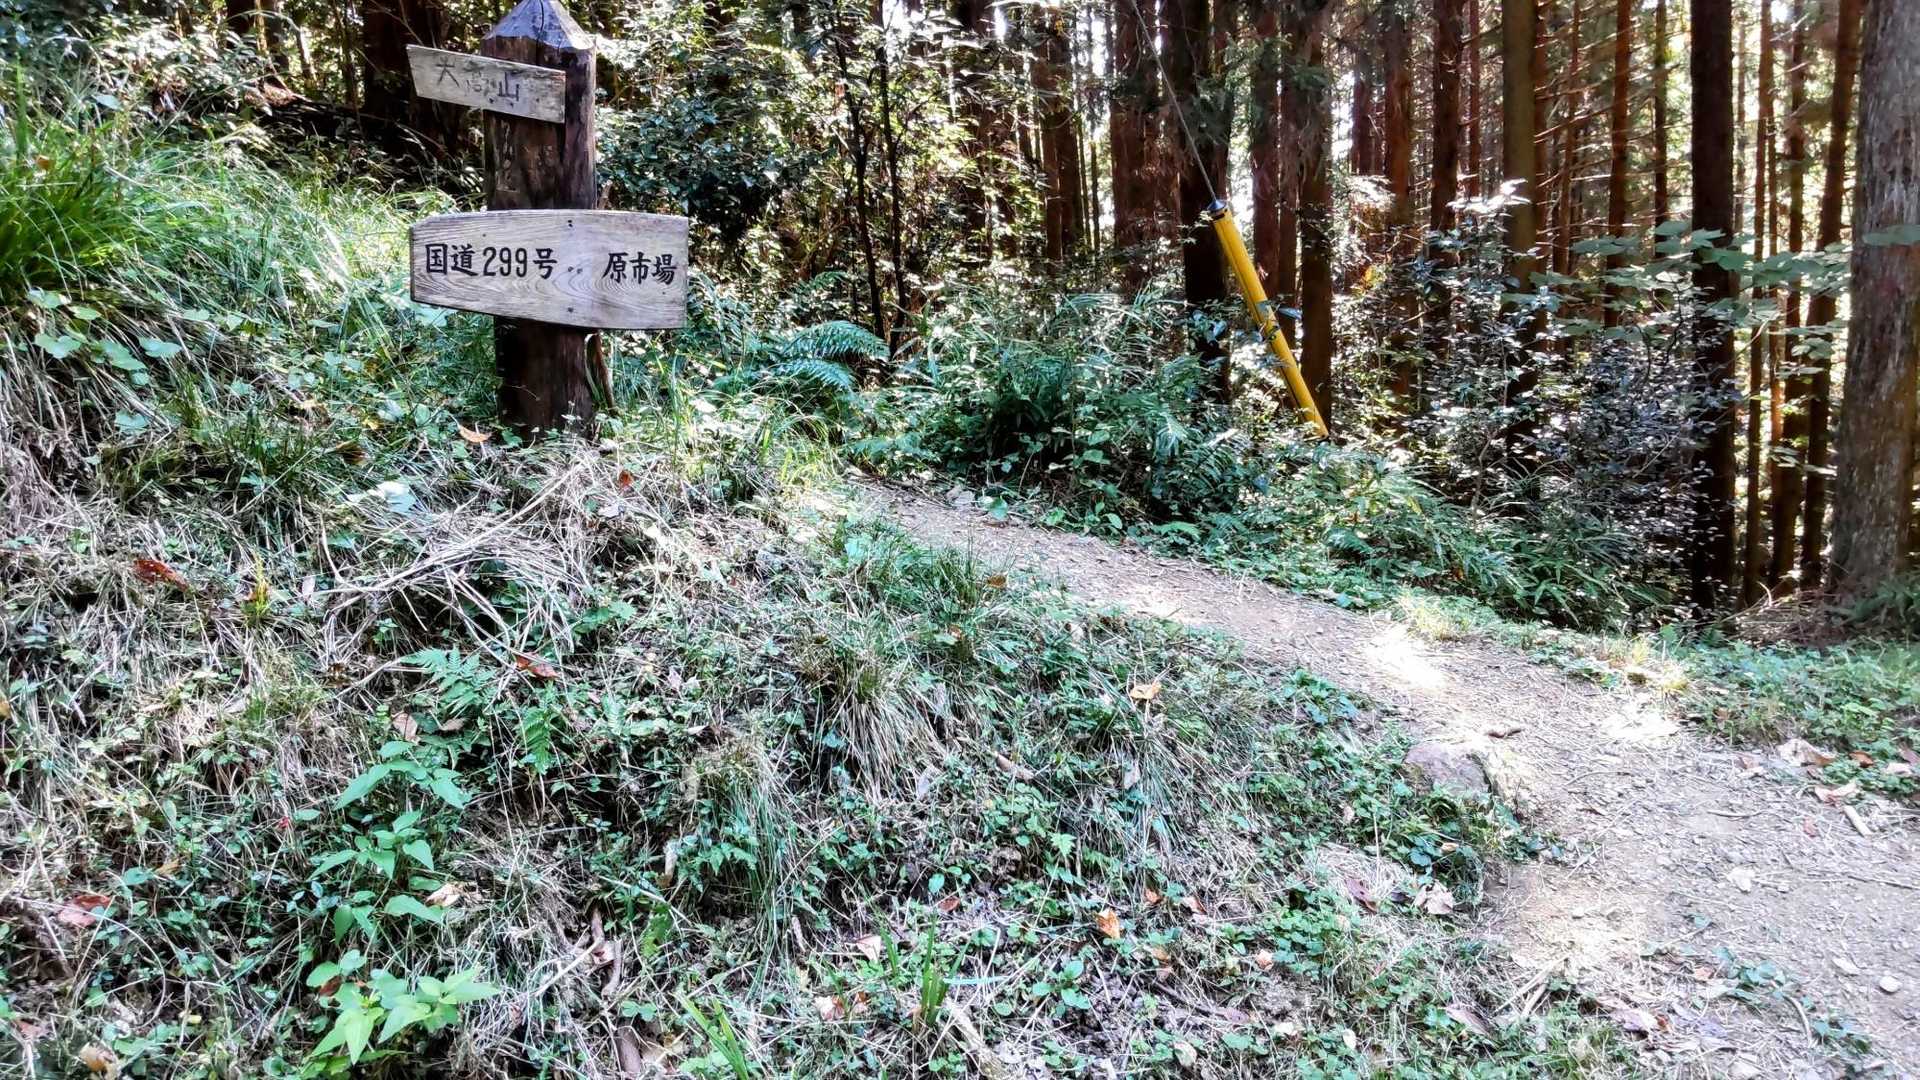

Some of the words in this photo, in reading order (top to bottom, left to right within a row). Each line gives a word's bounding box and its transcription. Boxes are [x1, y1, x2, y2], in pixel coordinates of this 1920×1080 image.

[425, 243, 558, 280] 国道299号
[602, 251, 678, 285] 原市場
